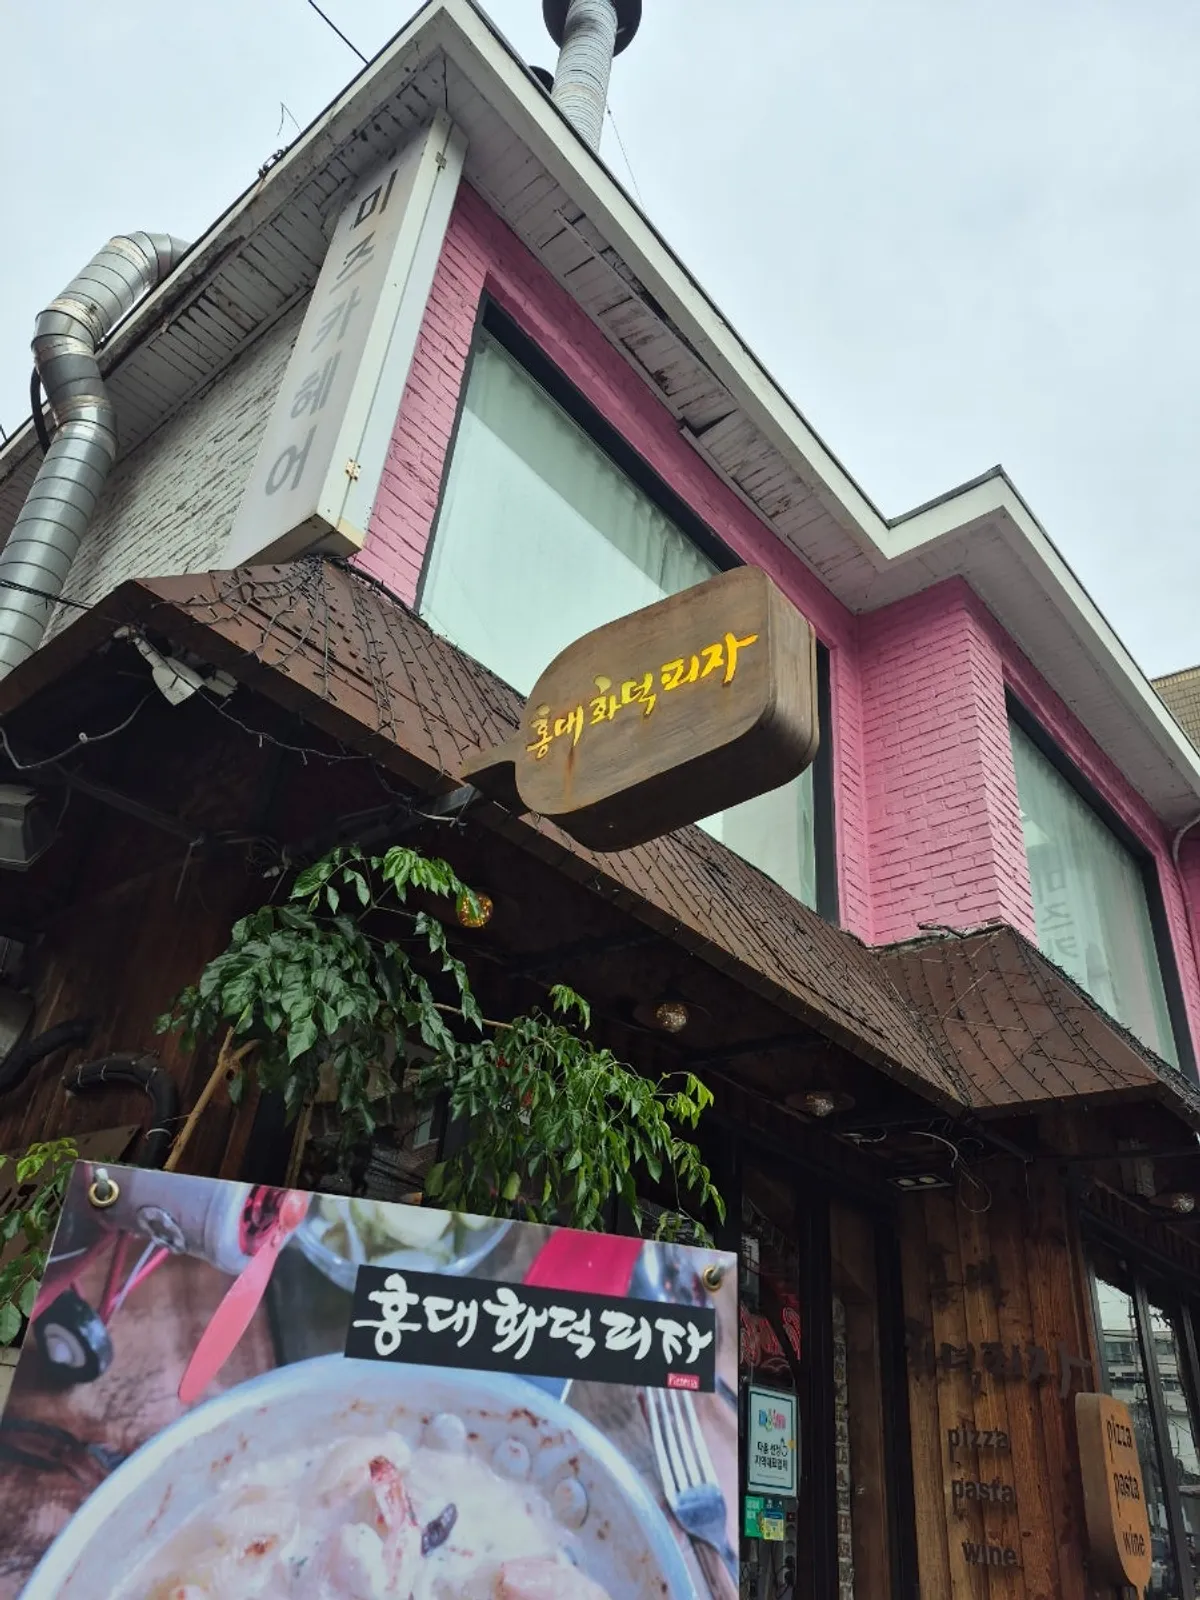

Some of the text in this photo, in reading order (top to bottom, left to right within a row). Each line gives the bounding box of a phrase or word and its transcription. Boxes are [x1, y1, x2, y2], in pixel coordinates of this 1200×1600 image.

[948, 1422, 1010, 1461] pizza
[1106, 1415, 1132, 1464] pizza
[951, 1477, 1016, 1519] pasta
[1113, 1470, 1140, 1517] pasta
[961, 1538, 1018, 1566] wine
[1123, 1526, 1145, 1557] wine
